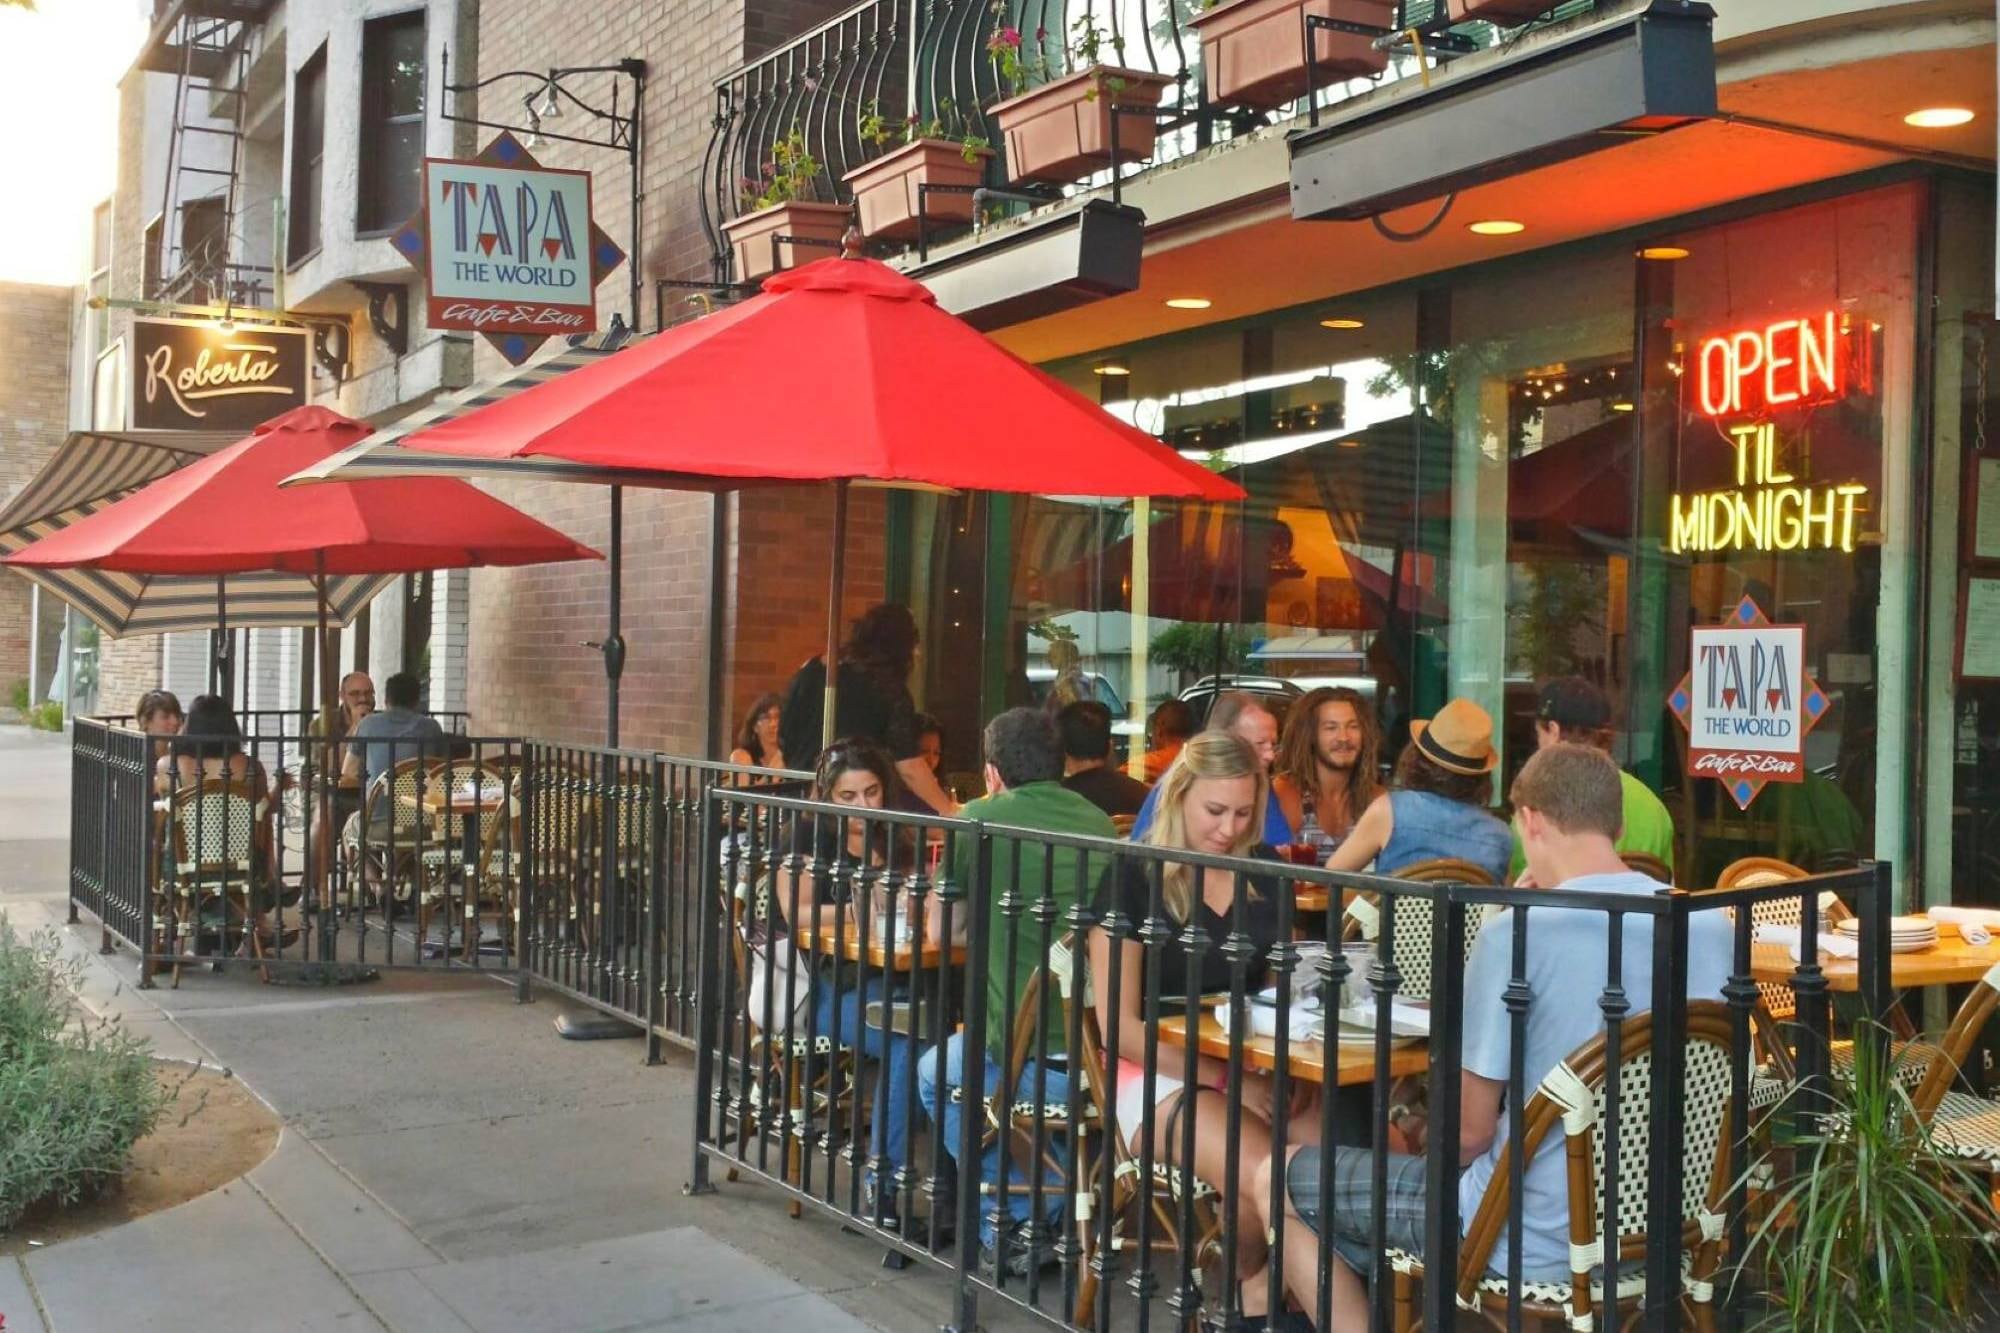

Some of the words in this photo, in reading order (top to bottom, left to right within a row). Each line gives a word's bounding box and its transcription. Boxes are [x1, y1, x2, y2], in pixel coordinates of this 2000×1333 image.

[442, 180, 576, 264] TAPA
[453, 262, 490, 282] THE
[494, 264, 576, 287] WORLD
[145, 344, 294, 418] Roberta
[1701, 310, 1836, 415] OPEN
[1730, 422, 1795, 486] TIL
[1671, 485, 1868, 555] MIDNIGHT
[1700, 638, 1791, 716] TAPA
[1704, 717, 1730, 735] THE
[1733, 718, 1791, 737] WORLD
